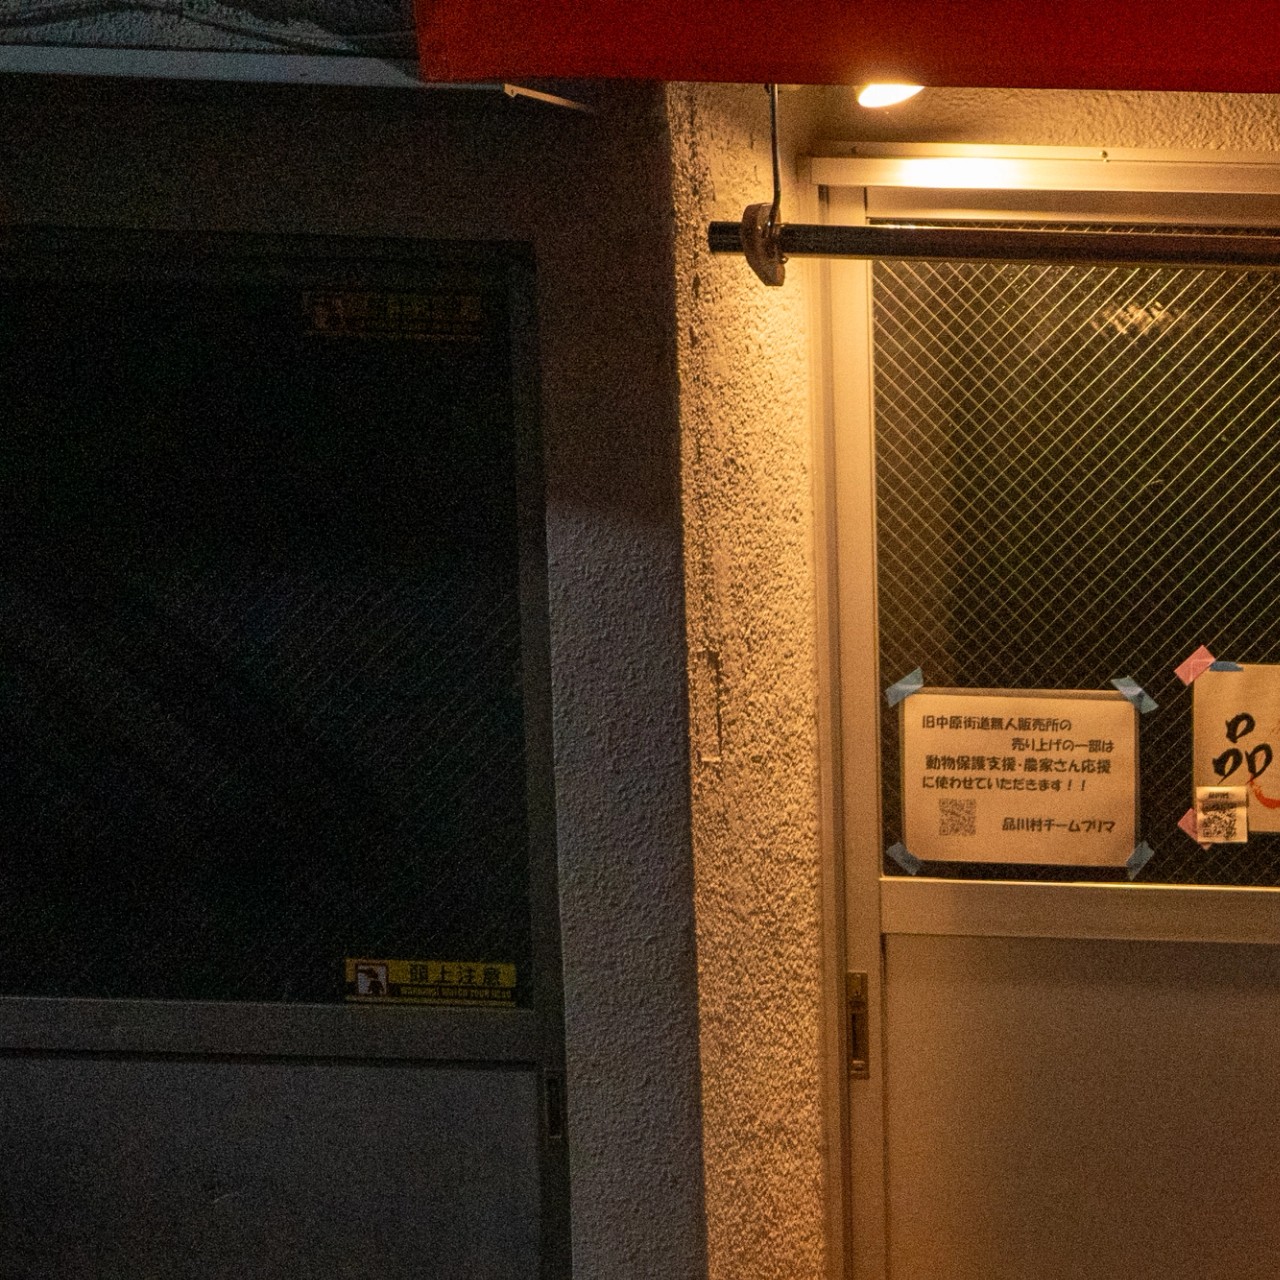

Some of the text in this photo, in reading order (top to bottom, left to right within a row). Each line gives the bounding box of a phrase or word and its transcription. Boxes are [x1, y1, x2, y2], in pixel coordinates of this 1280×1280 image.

[922, 715, 1072, 732] 旧中原街道無人販売所の
[1011, 737, 1115, 754] 売り上げの一部は
